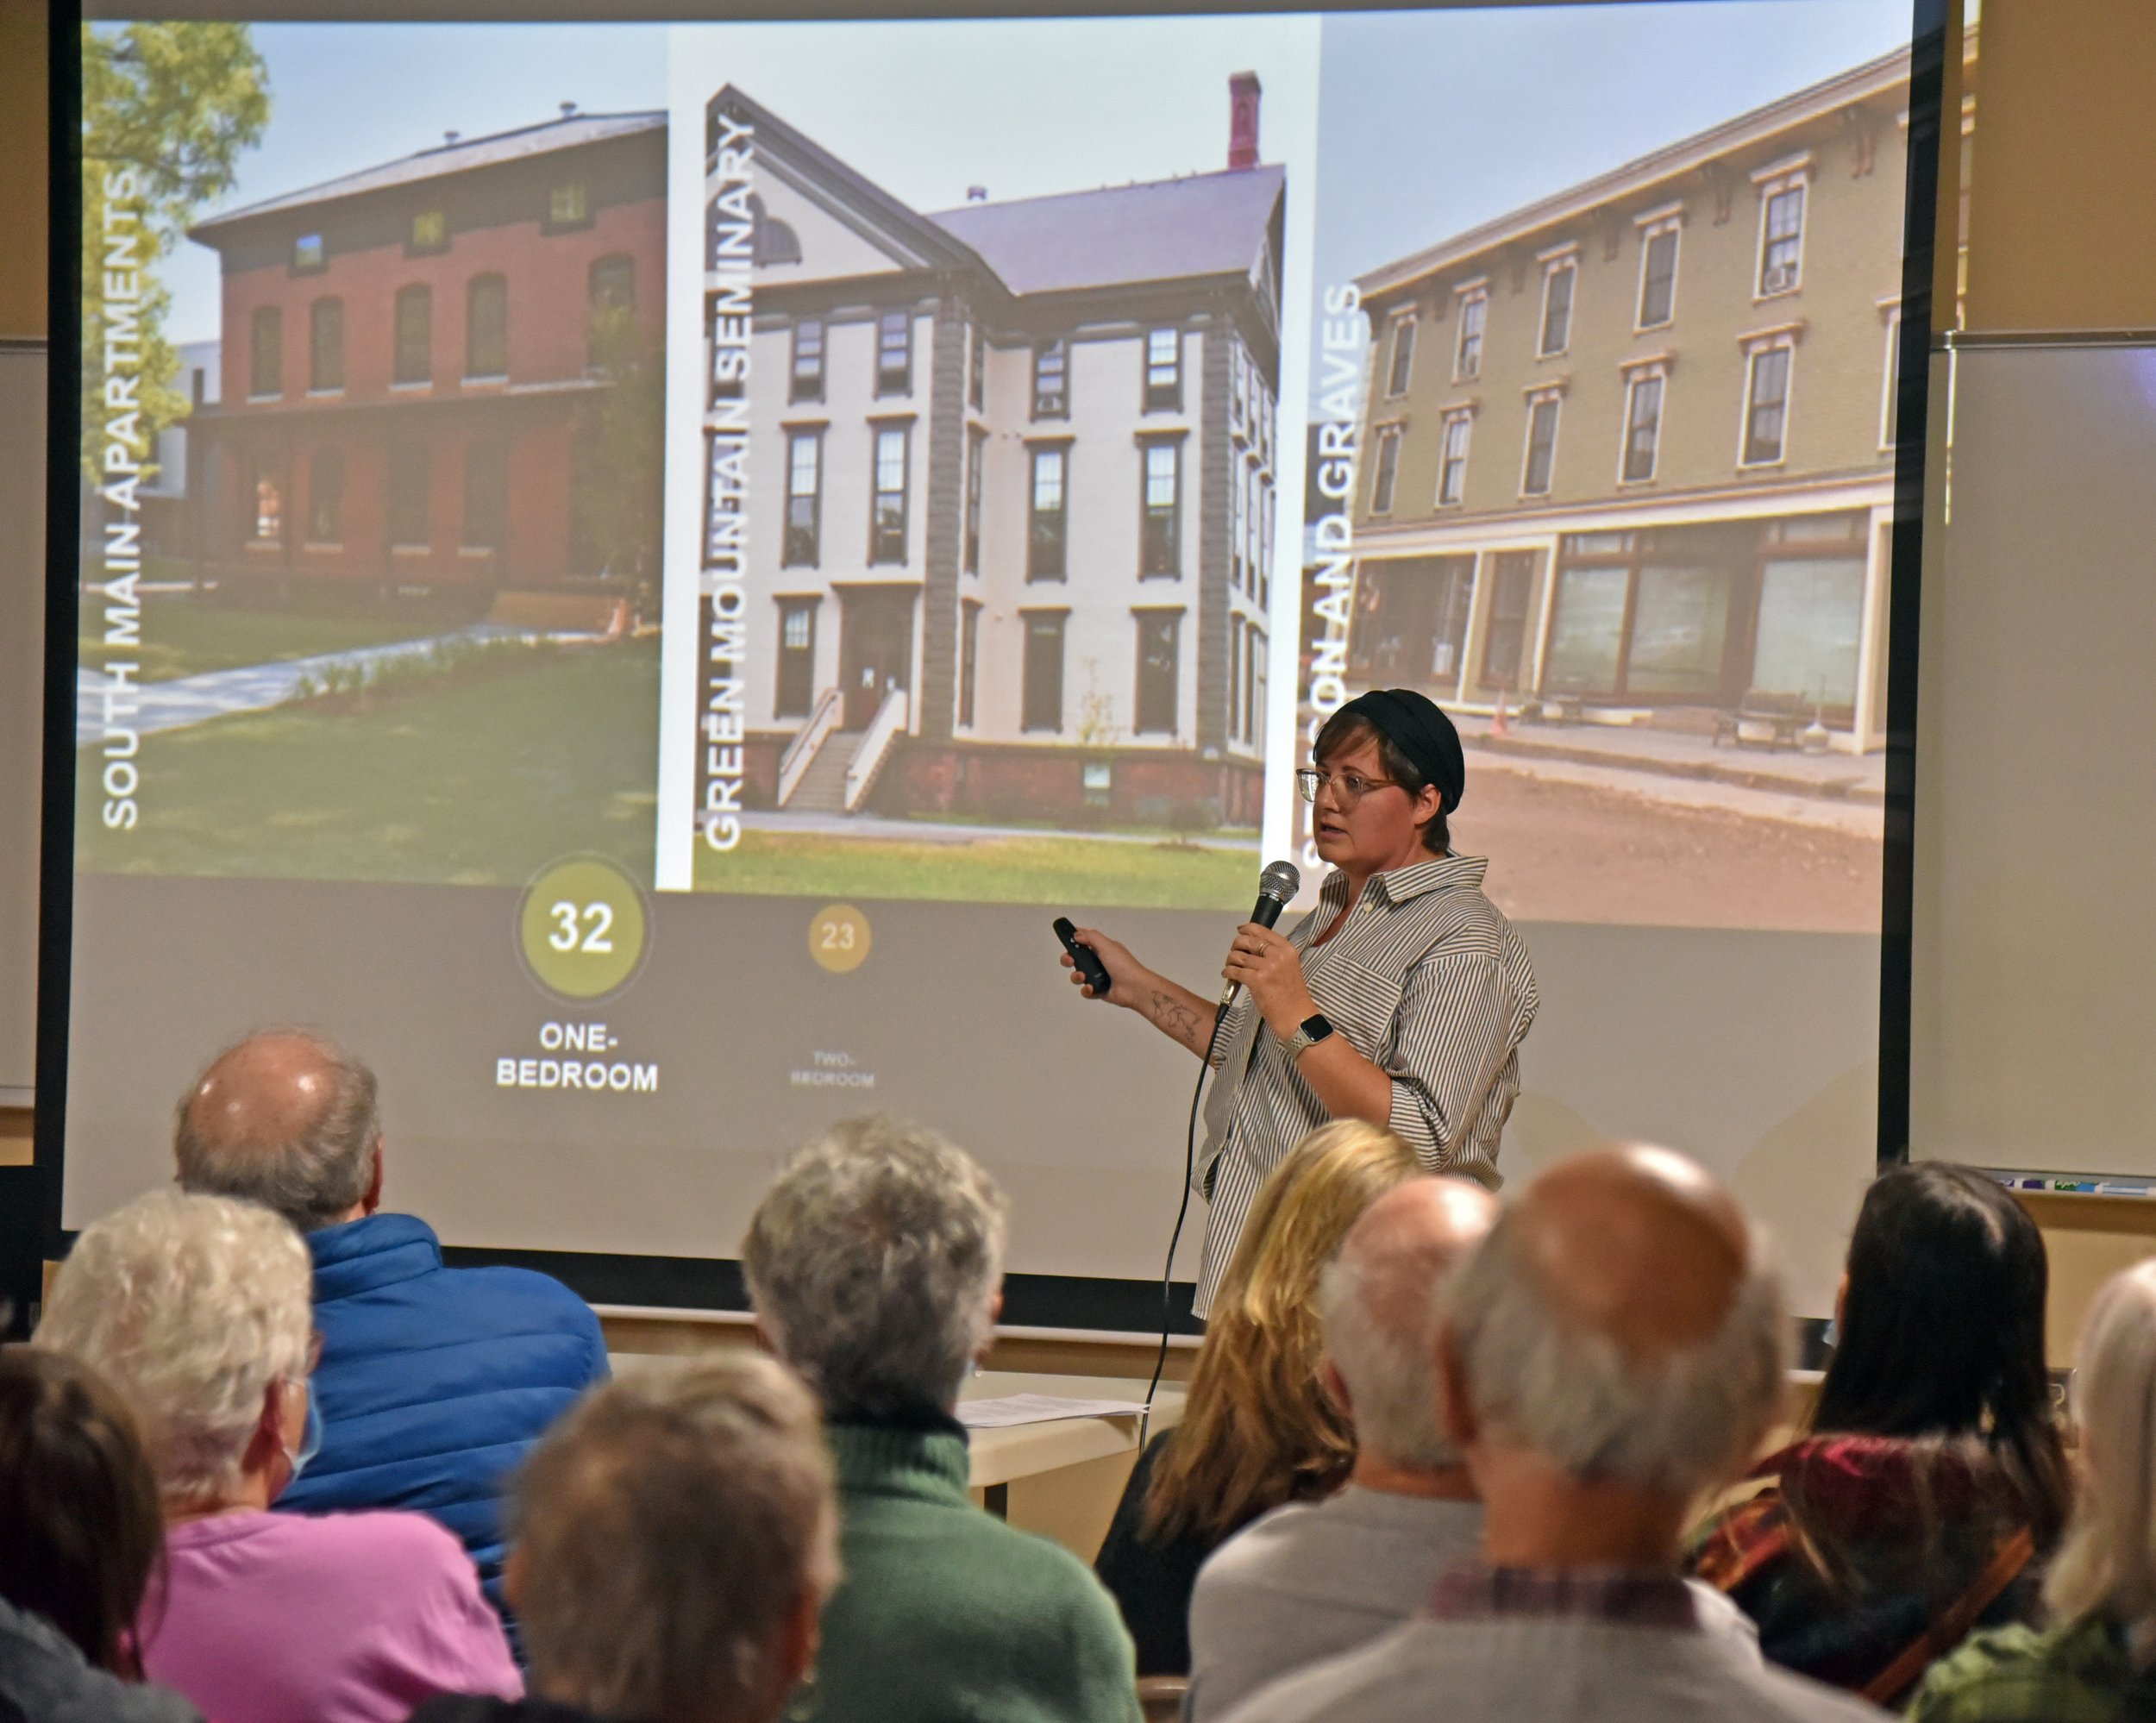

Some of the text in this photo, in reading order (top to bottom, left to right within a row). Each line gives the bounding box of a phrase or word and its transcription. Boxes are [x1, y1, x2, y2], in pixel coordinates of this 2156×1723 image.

[1315, 283, 1363, 500] GRAVES
[102, 170, 141, 830] SOUTH MAIN APARTMENTS
[705, 112, 755, 853] GREEN MOUNTAIN SEMINARY
[1311, 514, 1353, 626] AND
[548, 901, 613, 953] 32
[821, 922, 856, 949] 23
[496, 1058, 658, 1092] BEDROOM
[539, 1022, 618, 1051] ONE-
